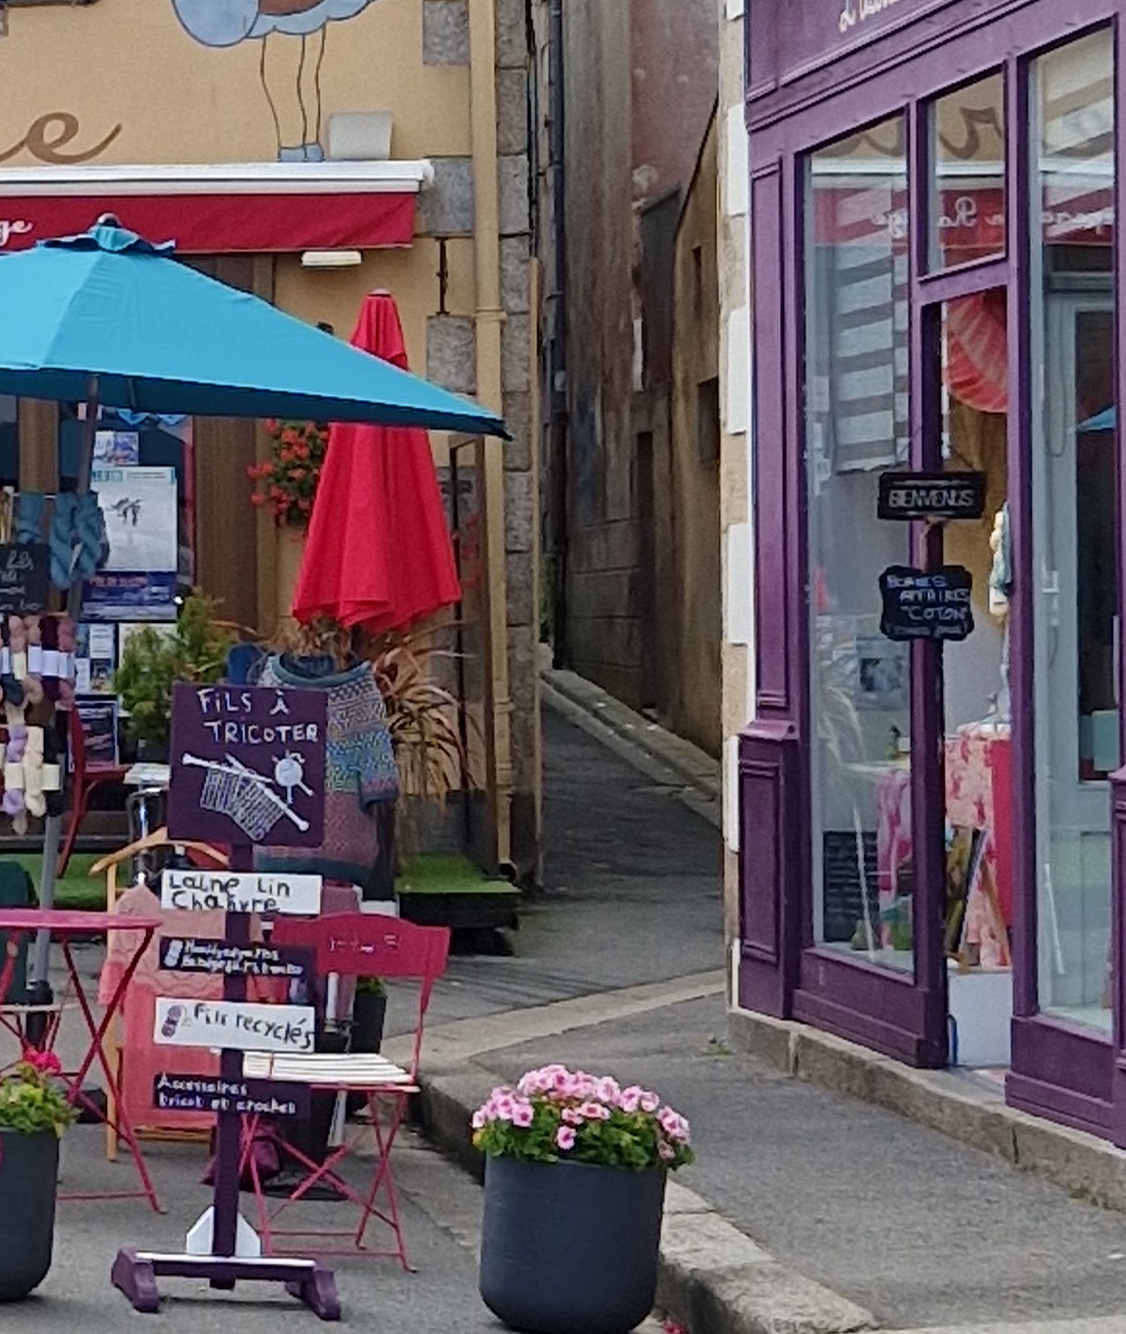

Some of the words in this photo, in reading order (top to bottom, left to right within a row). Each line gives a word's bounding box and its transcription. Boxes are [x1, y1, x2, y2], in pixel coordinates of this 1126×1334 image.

[168, 873, 240, 894] Laine
[256, 878, 291, 898] Lin
[235, 1013, 315, 1050] recyclés
